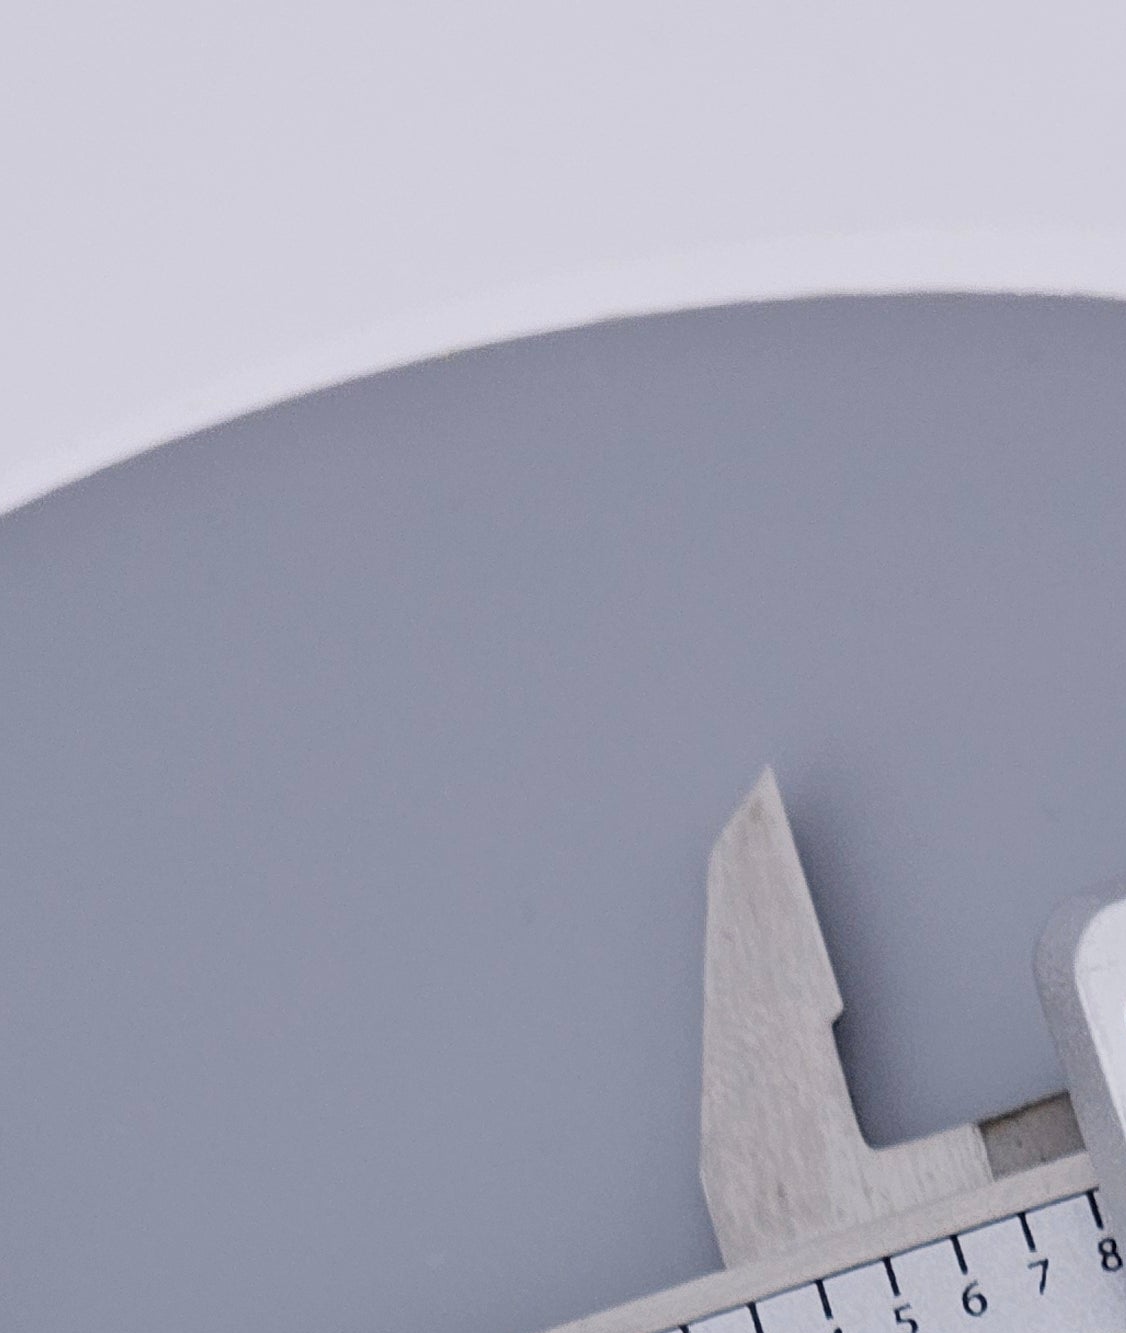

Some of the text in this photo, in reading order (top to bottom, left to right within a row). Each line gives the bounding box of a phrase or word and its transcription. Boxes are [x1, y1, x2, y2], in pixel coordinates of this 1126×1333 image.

[961, 1281, 989, 1318] 6
[1027, 1257, 1052, 1296] 7
[1098, 1237, 1124, 1273] 8
